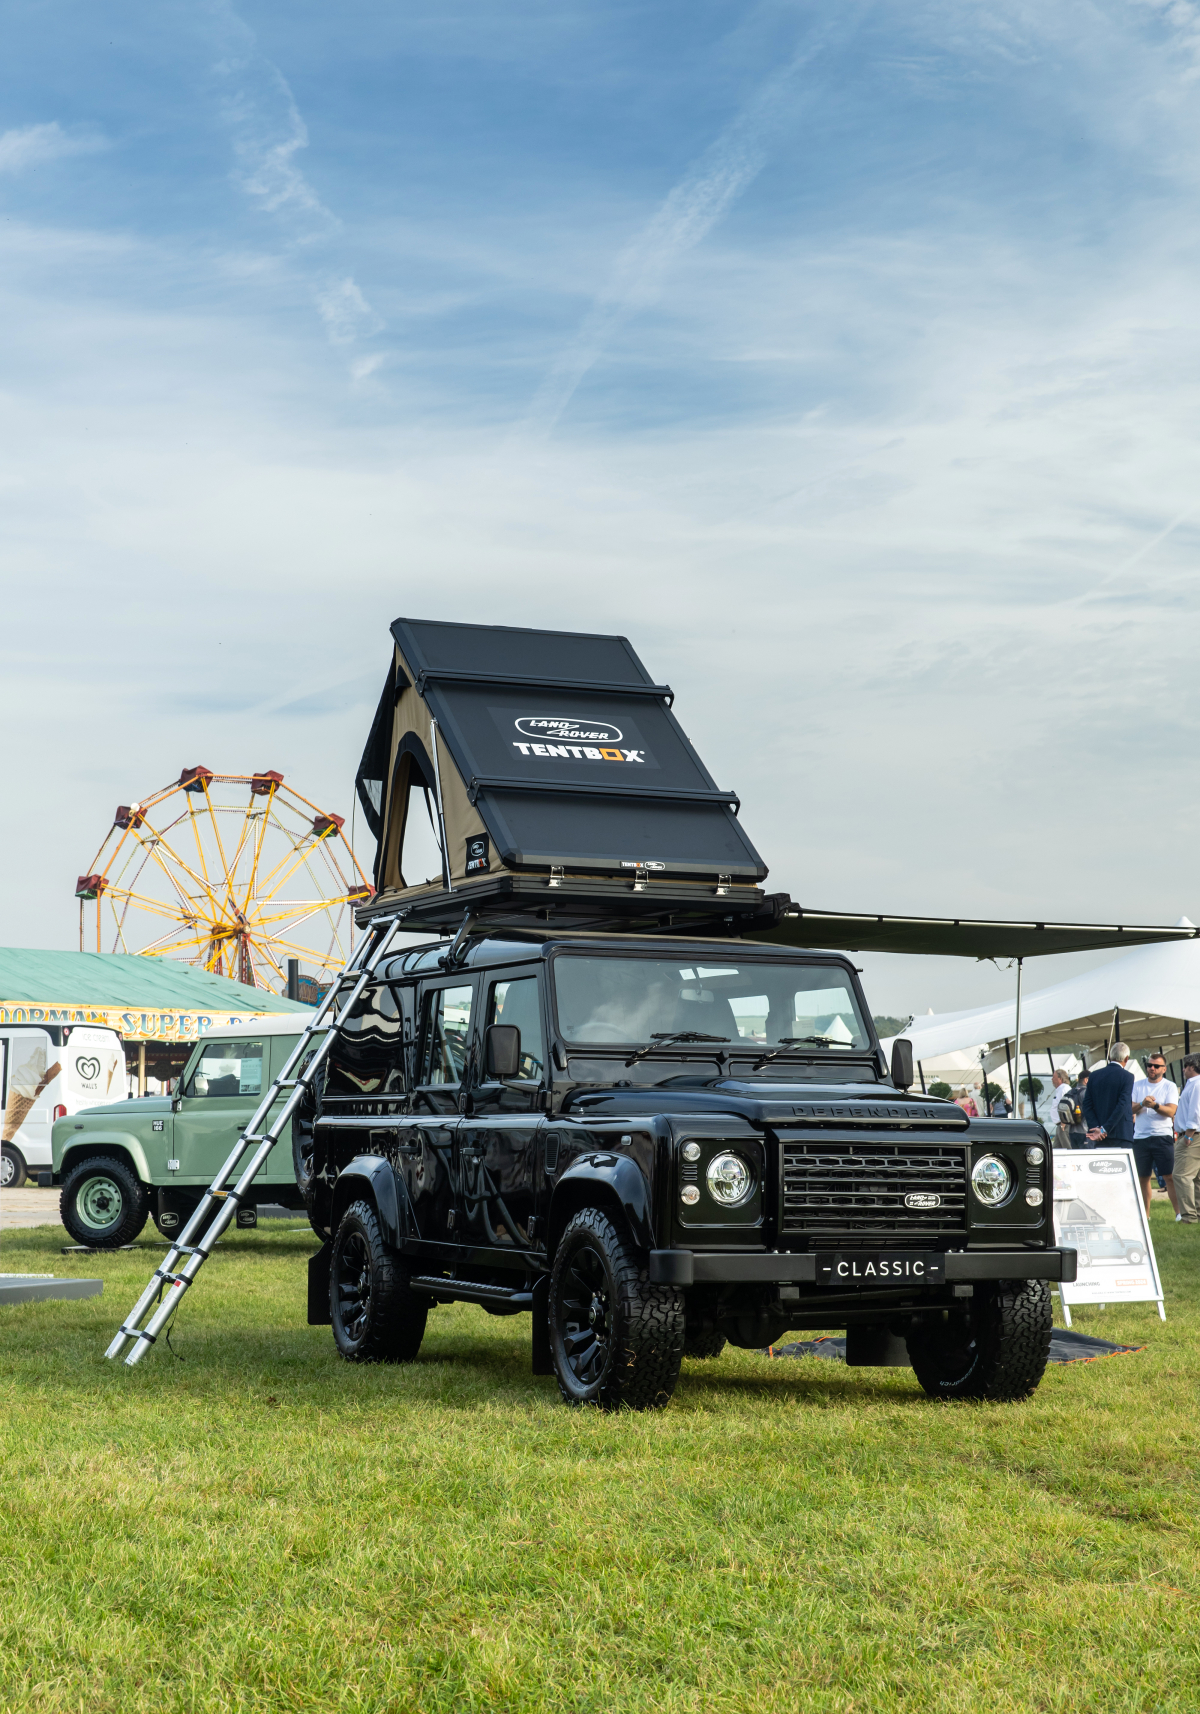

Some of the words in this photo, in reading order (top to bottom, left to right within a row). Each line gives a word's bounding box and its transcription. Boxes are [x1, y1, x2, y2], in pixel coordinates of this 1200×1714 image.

[530, 720, 574, 729] LAND
[557, 731, 608, 739] ROVER
[512, 742, 645, 762] TENTBOX
[120, 1012, 213, 1037] SUPER
[81, 1082, 98, 1090] WALL'S
[792, 1106, 938, 1118] DEFENDER
